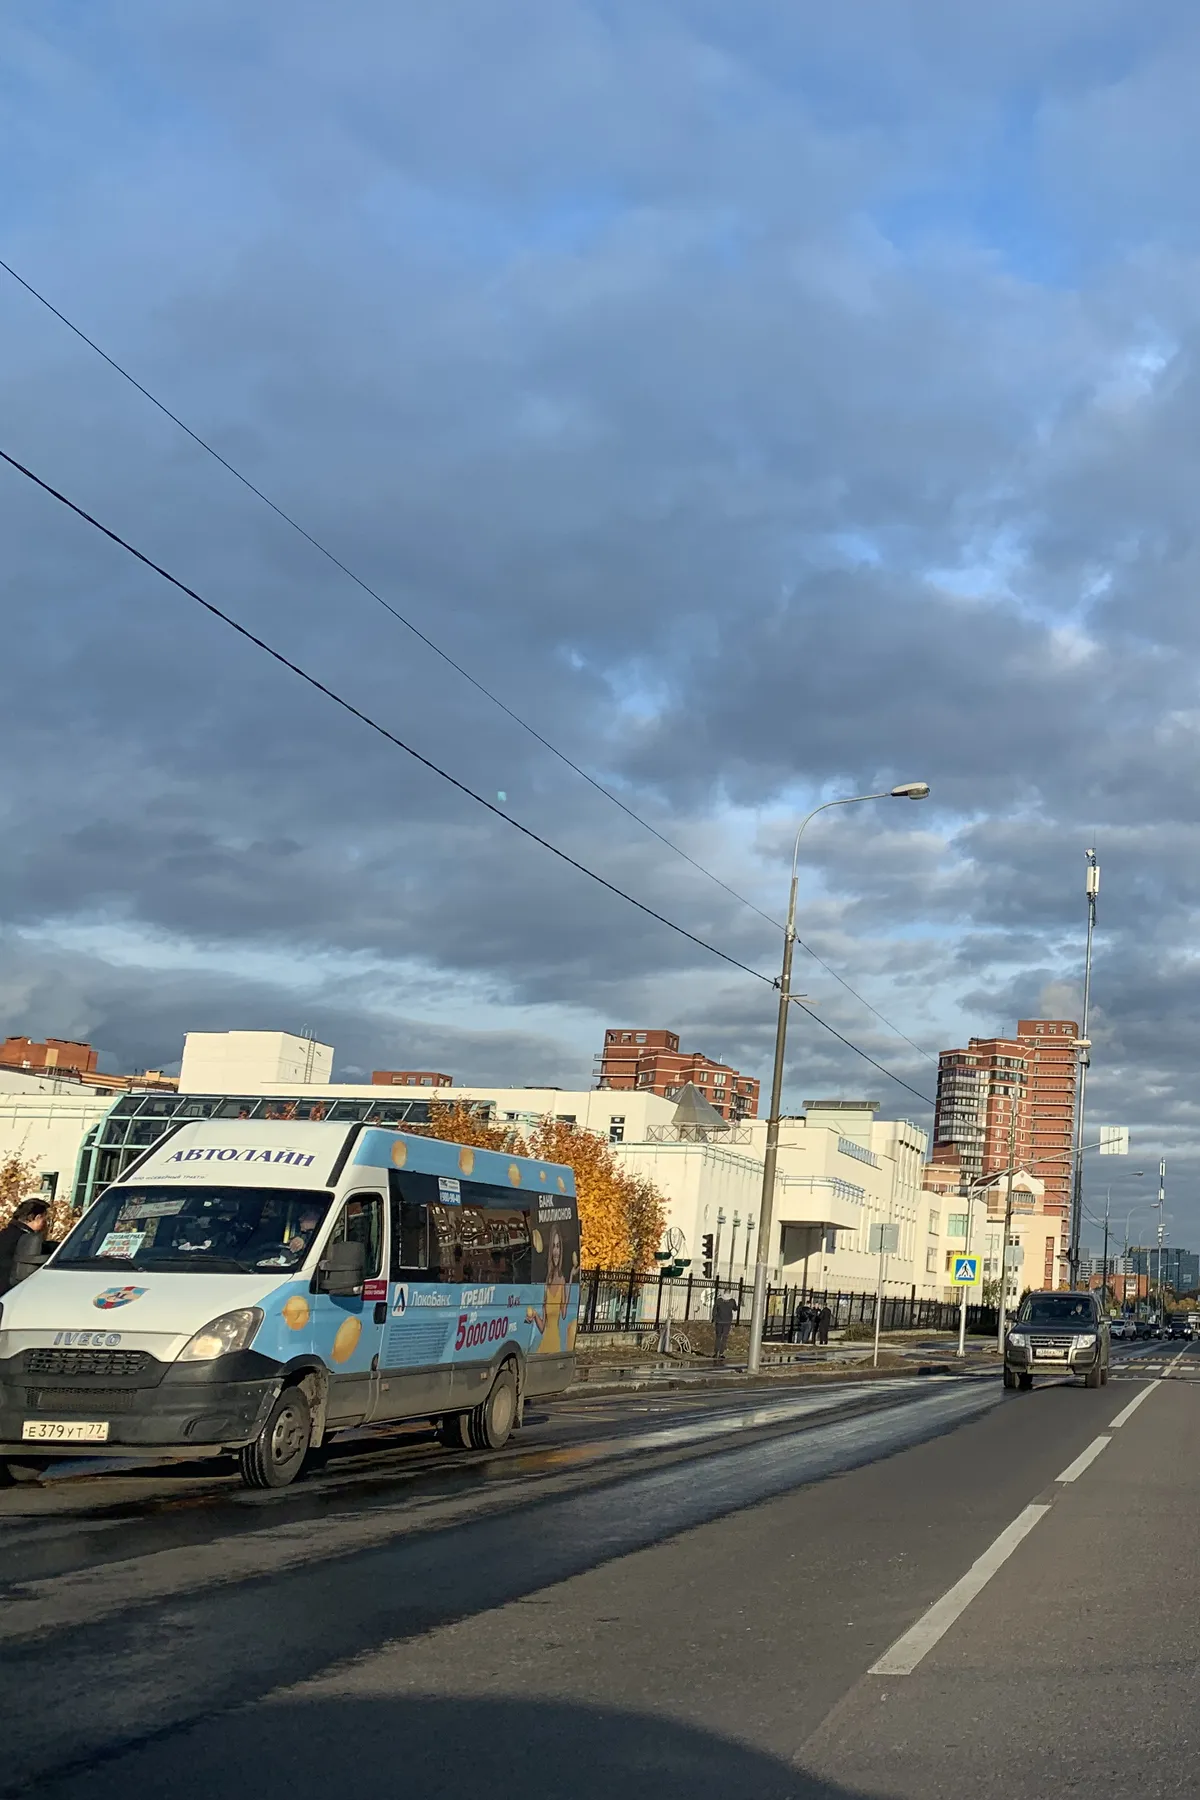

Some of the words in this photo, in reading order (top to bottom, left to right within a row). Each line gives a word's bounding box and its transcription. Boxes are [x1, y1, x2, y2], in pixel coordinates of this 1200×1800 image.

[164, 1147, 316, 1167] АВТОЛАЙН
[538, 1195, 554, 1208] БАНК
[538, 1207, 572, 1223] МИЛЛИОНОВ
[460, 1286, 496, 1309] КРЕДИТ
[53, 1332, 122, 1346] IVECO
